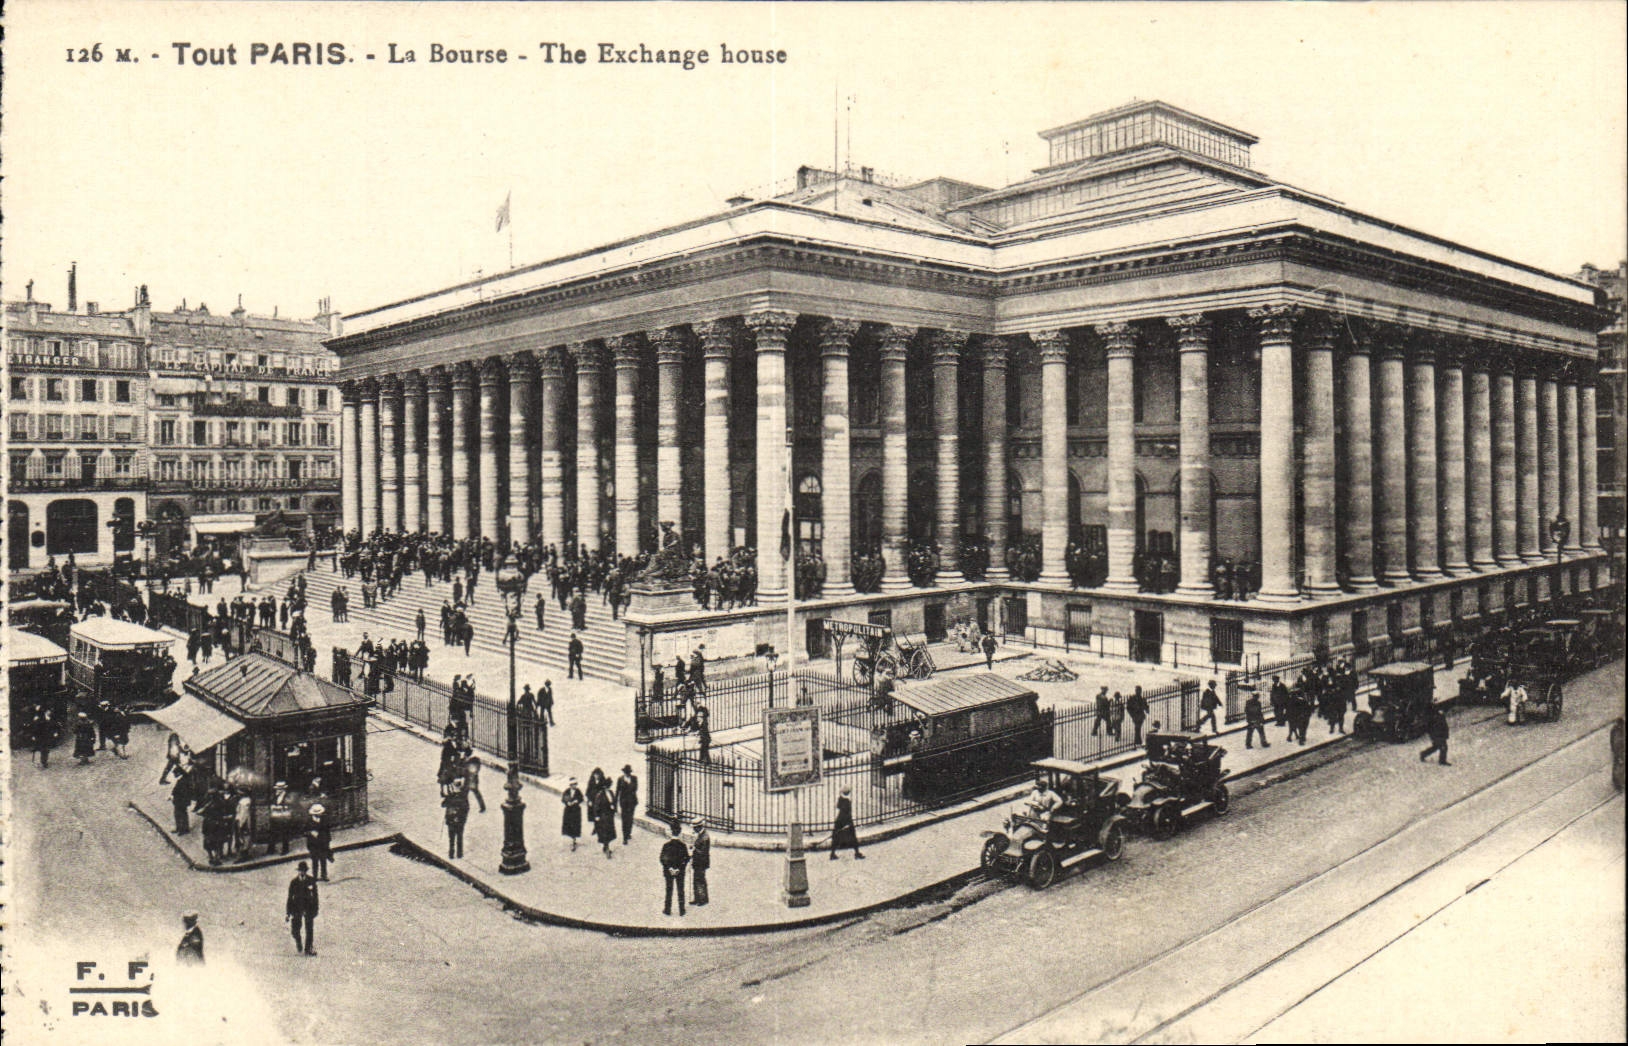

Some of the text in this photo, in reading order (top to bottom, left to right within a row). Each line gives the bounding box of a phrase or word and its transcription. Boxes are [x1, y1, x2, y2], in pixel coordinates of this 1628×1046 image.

[165, 361, 331, 377] LE CAPITAL DE FRANCE
[823, 620, 883, 638] METROPOLITAIN
